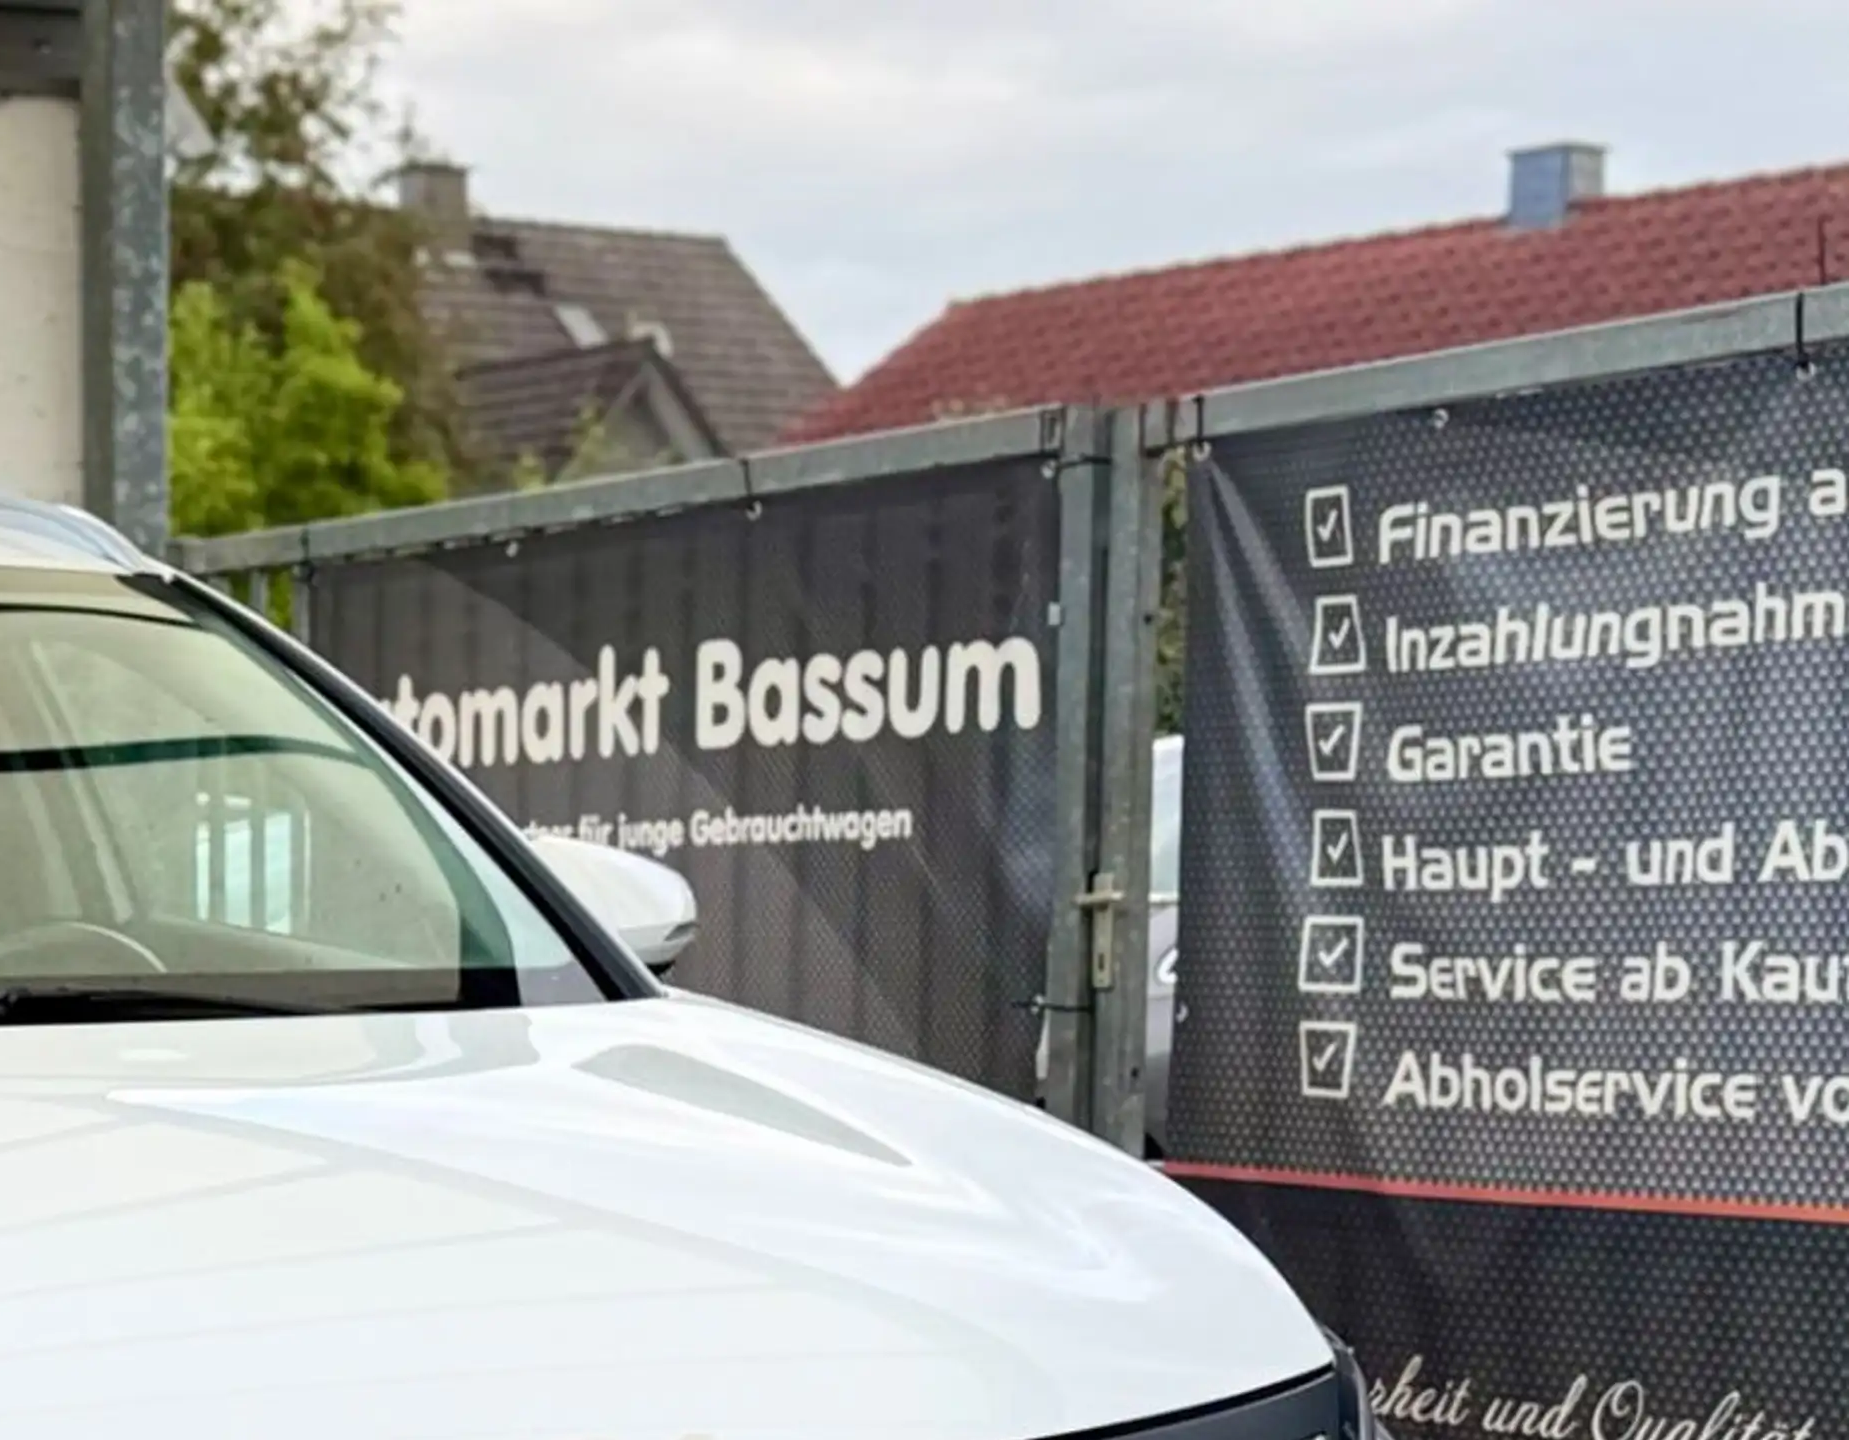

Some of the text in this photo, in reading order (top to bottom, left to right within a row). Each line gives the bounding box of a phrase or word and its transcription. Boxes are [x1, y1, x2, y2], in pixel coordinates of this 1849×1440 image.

[1378, 475, 1781, 564] Finanzierung
[1385, 581, 1846, 673] Inzahlungnahm
[379, 636, 1041, 769] tomarkt Bassum
[1386, 712, 1633, 783] Garantie
[617, 811, 685, 858] junge
[689, 802, 913, 850] Gebrauchtwagen
[1381, 830, 1549, 903] Haupt
[1626, 821, 1735, 886] und
[1389, 939, 1849, 1002] Service ab Kau
[1382, 1050, 1757, 1120] Abholservice
[1367, 1353, 1471, 1427] rheit
[1482, 1373, 1588, 1440] und
